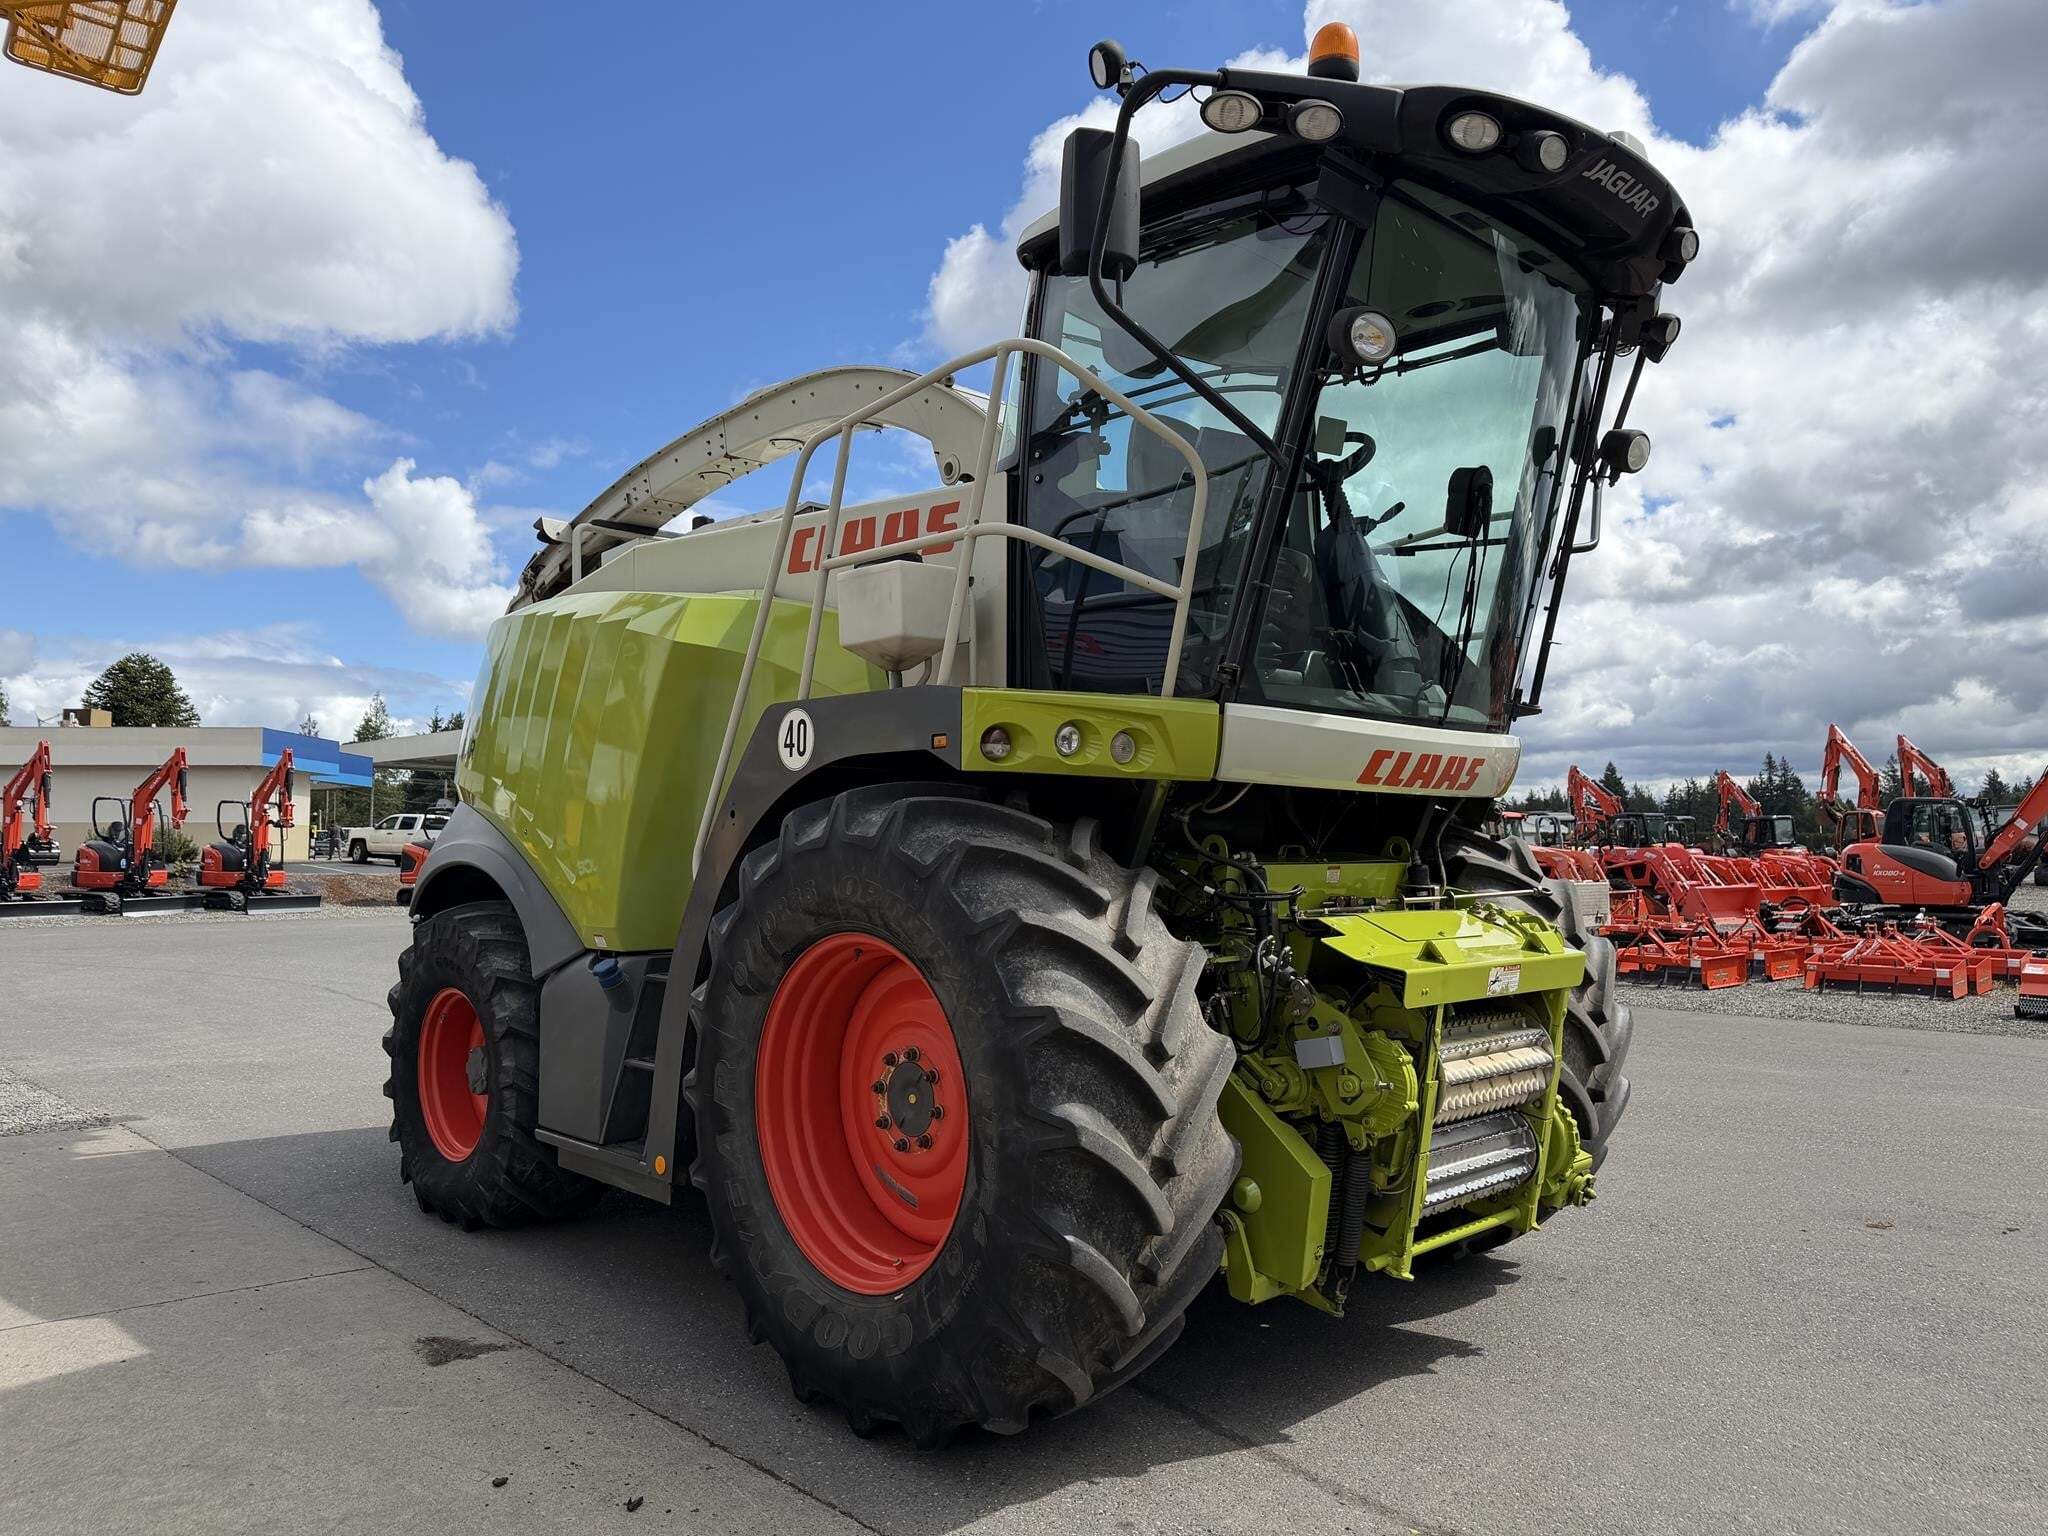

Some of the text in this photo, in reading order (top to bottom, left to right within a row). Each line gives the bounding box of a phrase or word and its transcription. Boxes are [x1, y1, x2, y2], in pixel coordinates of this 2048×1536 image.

[1582, 159, 1660, 218] JAGUAR
[784, 719, 807, 757] 40
[1356, 749, 1486, 791] CLAAS
